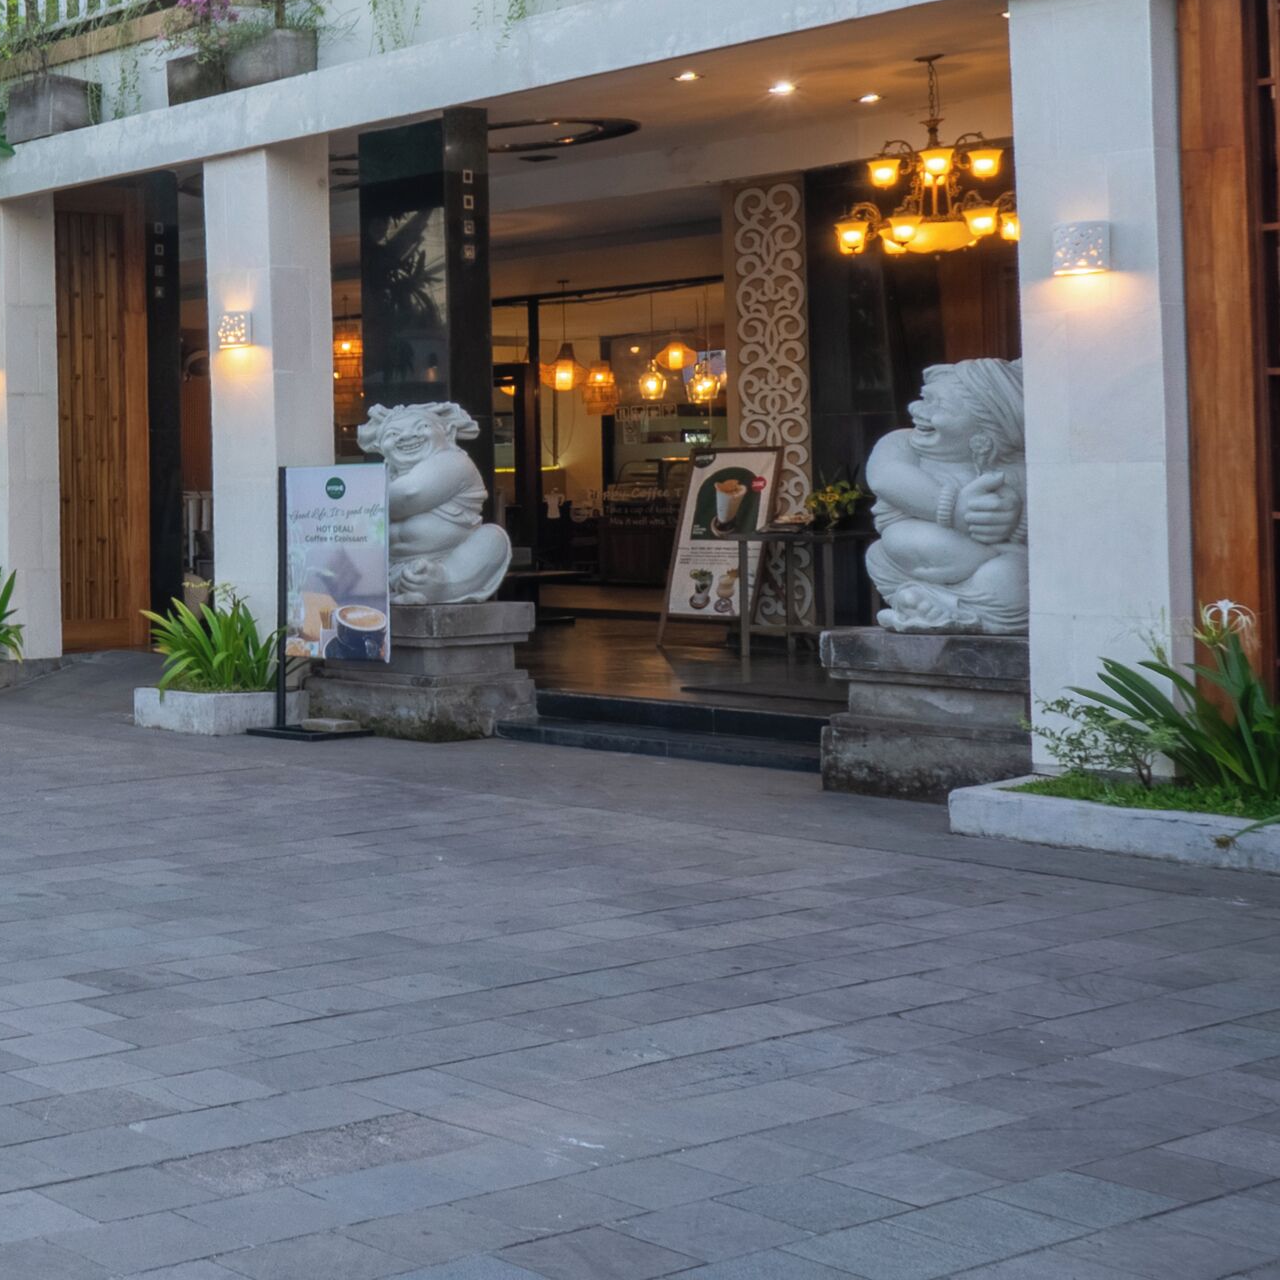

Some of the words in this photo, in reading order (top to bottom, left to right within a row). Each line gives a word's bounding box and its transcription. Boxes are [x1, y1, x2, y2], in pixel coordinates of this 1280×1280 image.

[316, 525, 331, 533] HOT
[305, 534, 328, 543] Coffee
[334, 534, 368, 543] Croissant
